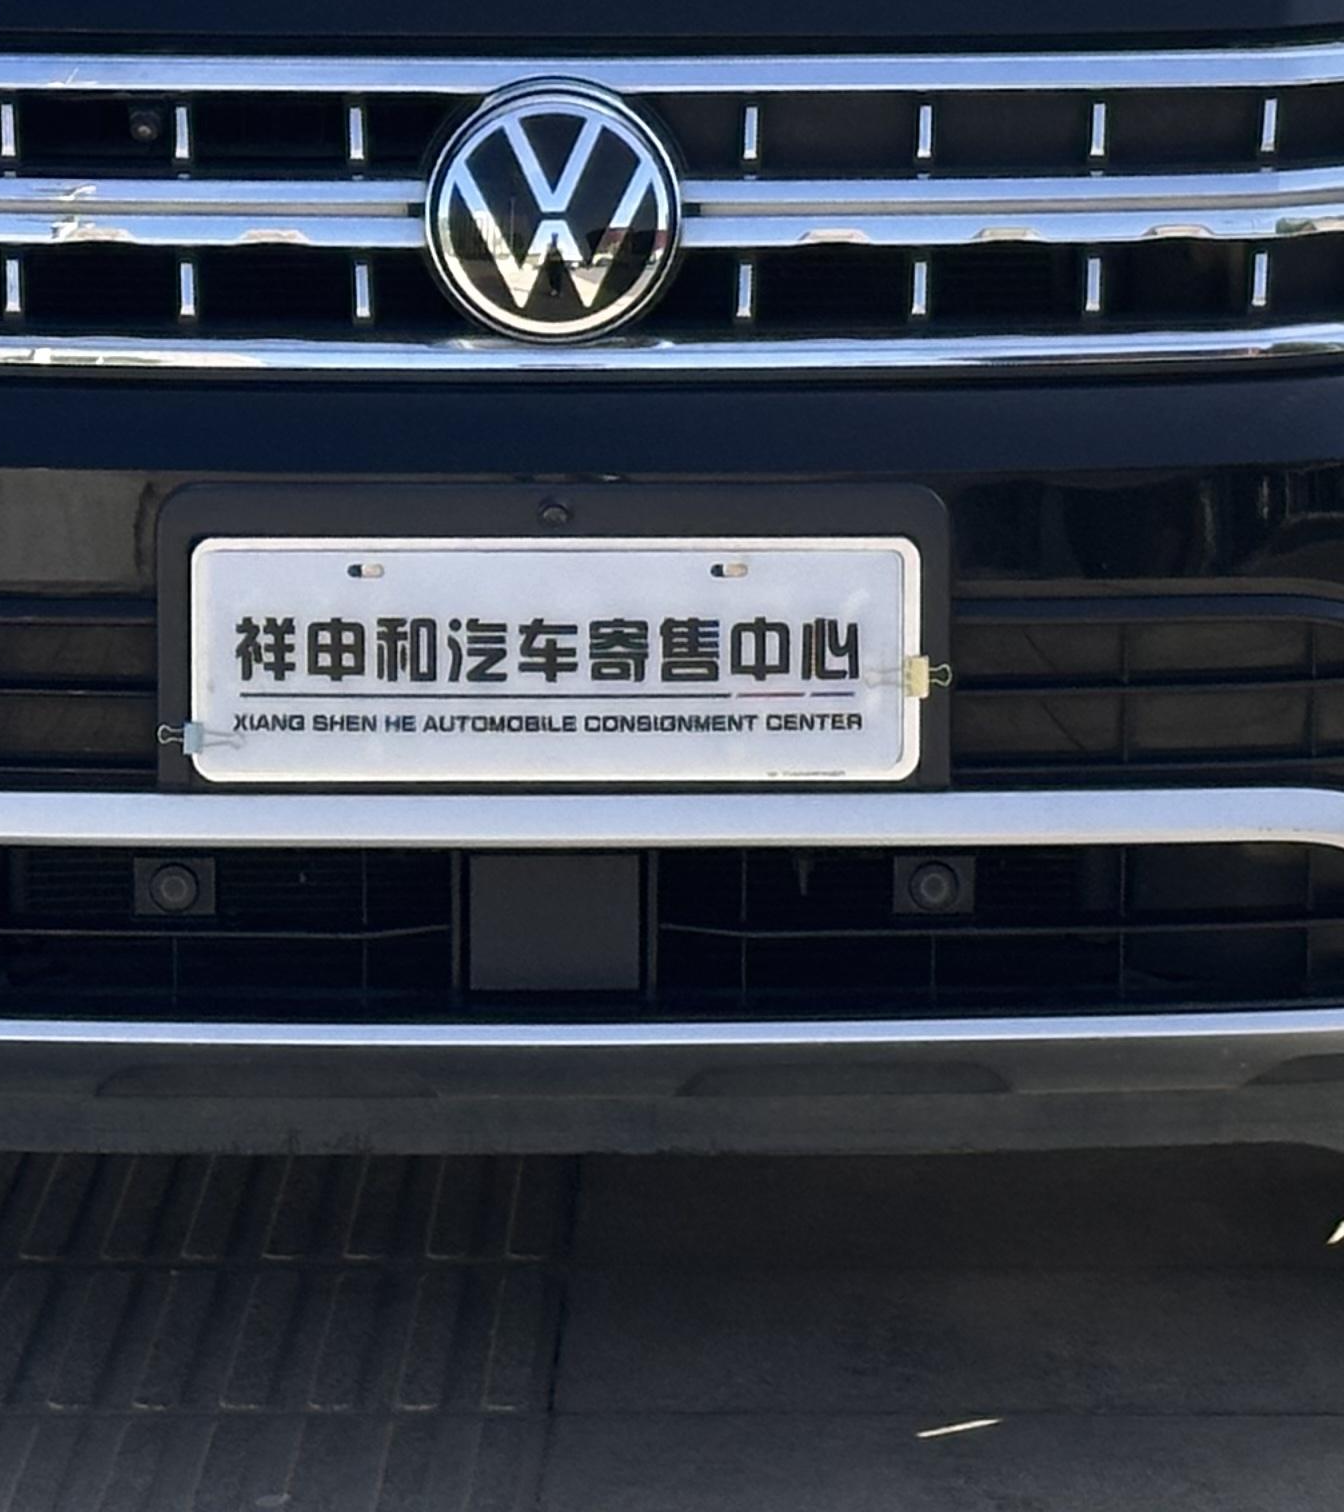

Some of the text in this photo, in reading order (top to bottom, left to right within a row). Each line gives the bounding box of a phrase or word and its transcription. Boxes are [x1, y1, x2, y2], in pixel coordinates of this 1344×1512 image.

[235, 616, 860, 683] 祥申和汽车寄售中心
[233, 712, 863, 733] XIANG SHEN HE AUTOMOBILE CONSIGNMENT CENTER
